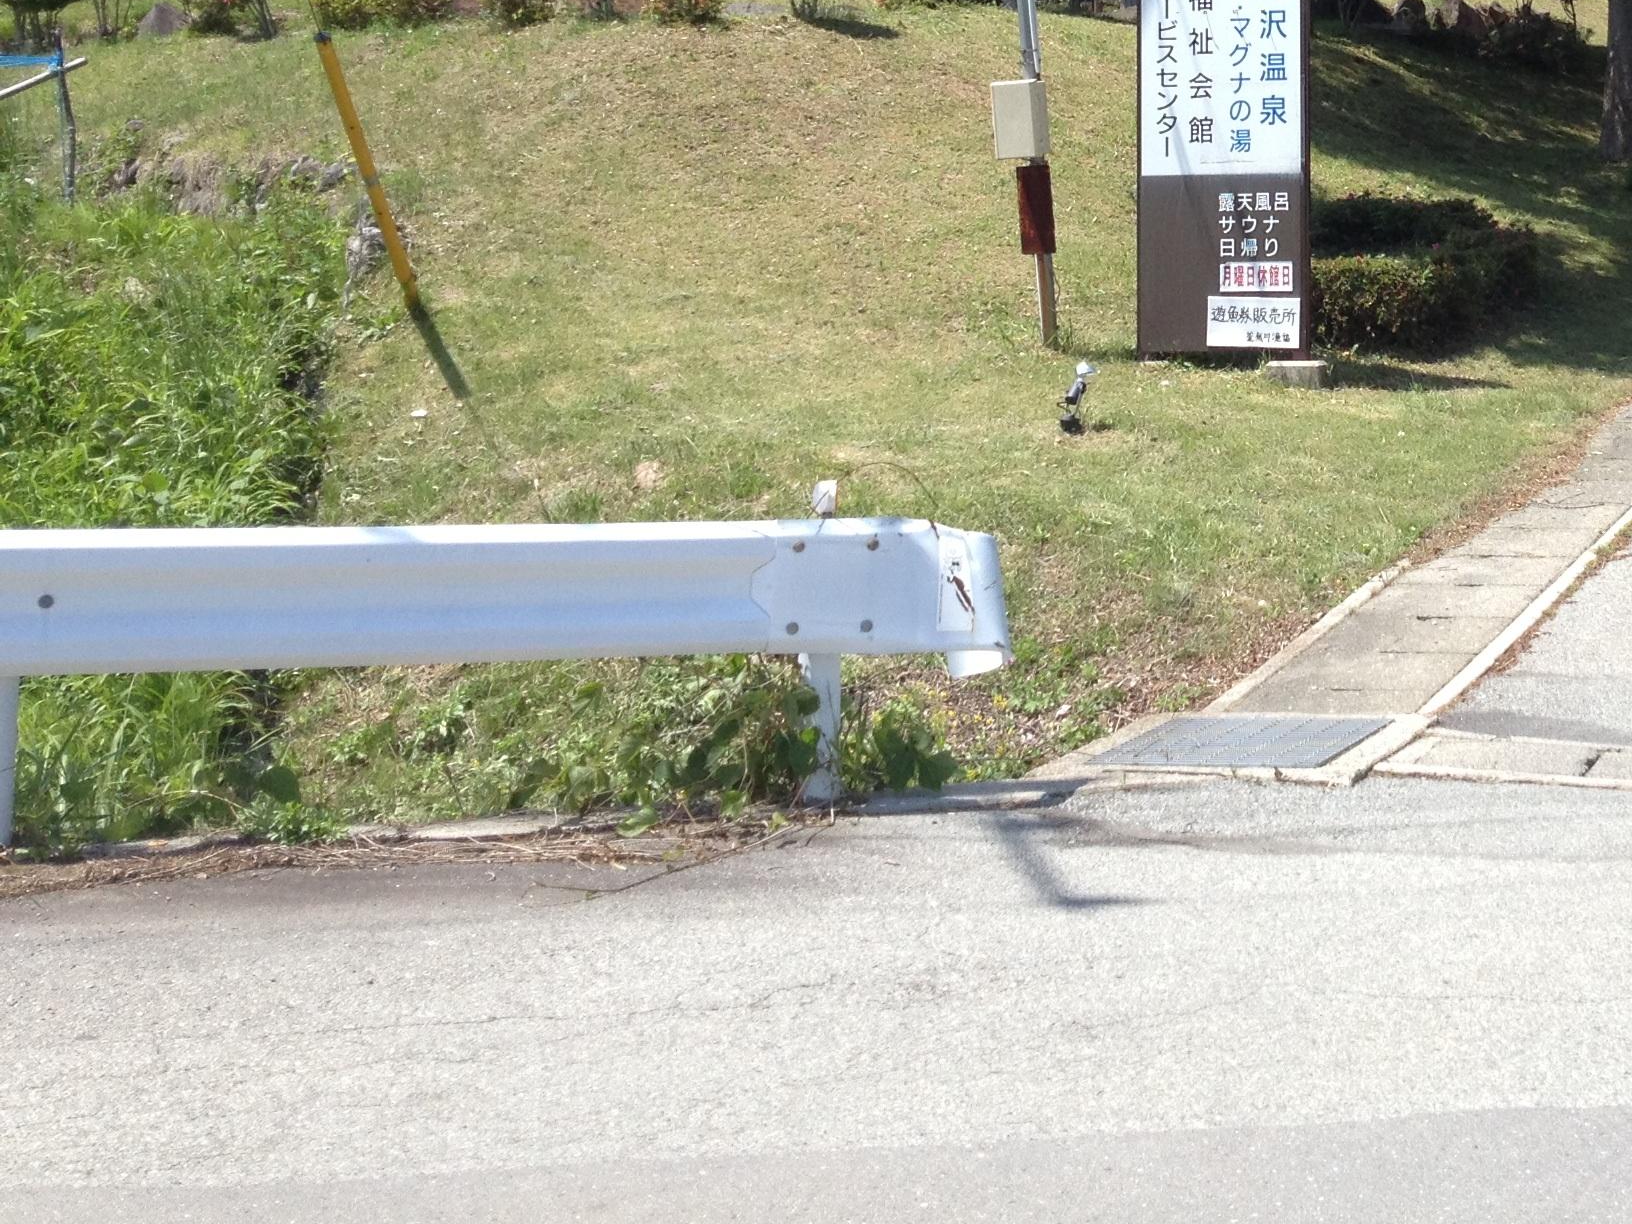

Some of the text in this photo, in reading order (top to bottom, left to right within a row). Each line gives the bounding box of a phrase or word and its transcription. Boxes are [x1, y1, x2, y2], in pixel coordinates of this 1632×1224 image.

[1218, 192, 1290, 212] 露天風呂
[1218, 215, 1280, 234] サウナ
[1219, 238, 1279, 257] 日帰り
[1222, 265, 1290, 287] 月曜日休館日
